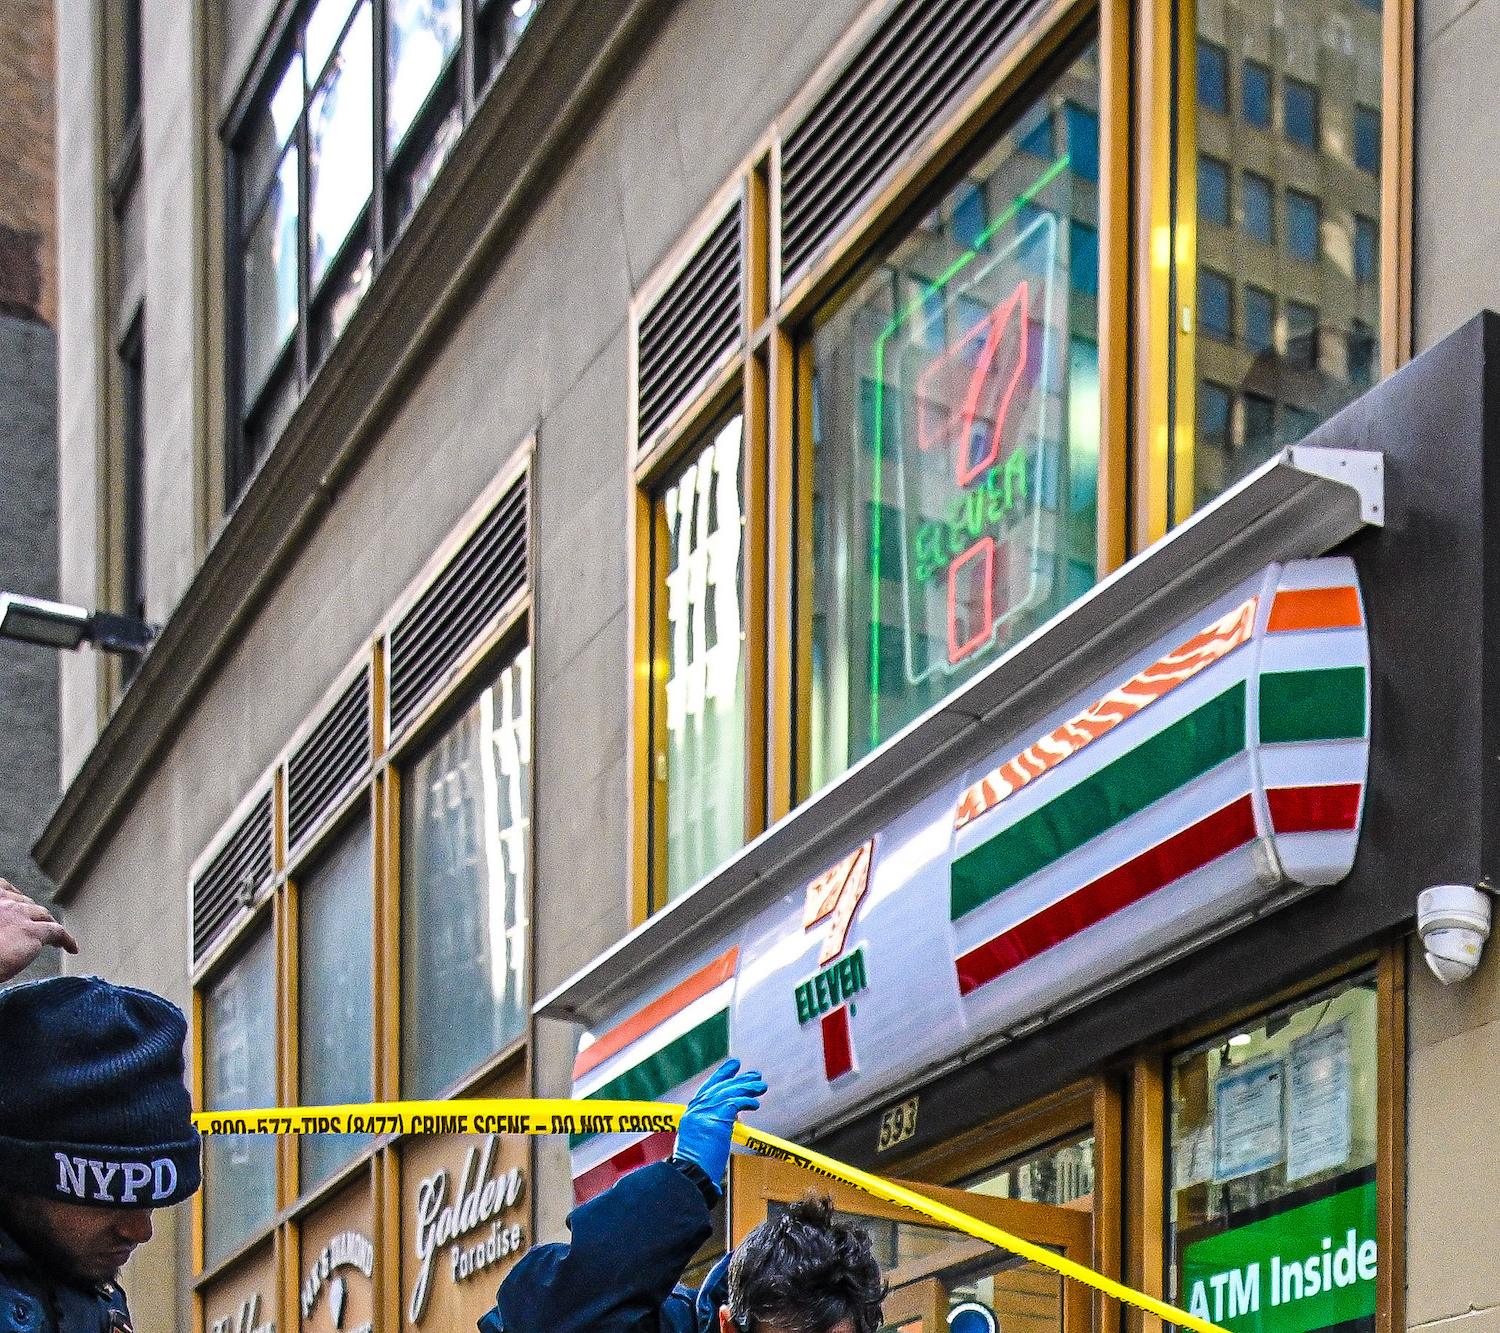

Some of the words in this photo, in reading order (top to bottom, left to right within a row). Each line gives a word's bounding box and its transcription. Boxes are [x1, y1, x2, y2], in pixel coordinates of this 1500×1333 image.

[411, 1115, 468, 1135] CRIME
[474, 1115, 530, 1134] SCENE
[551, 1115, 577, 1134] DO
[55, 1151, 179, 1201] NYPD
[409, 1134, 523, 1324] Golden
[450, 1223, 525, 1284] Paradise
[1186, 1262, 1260, 1327] ATM
[1270, 1228, 1378, 1306] Inside
